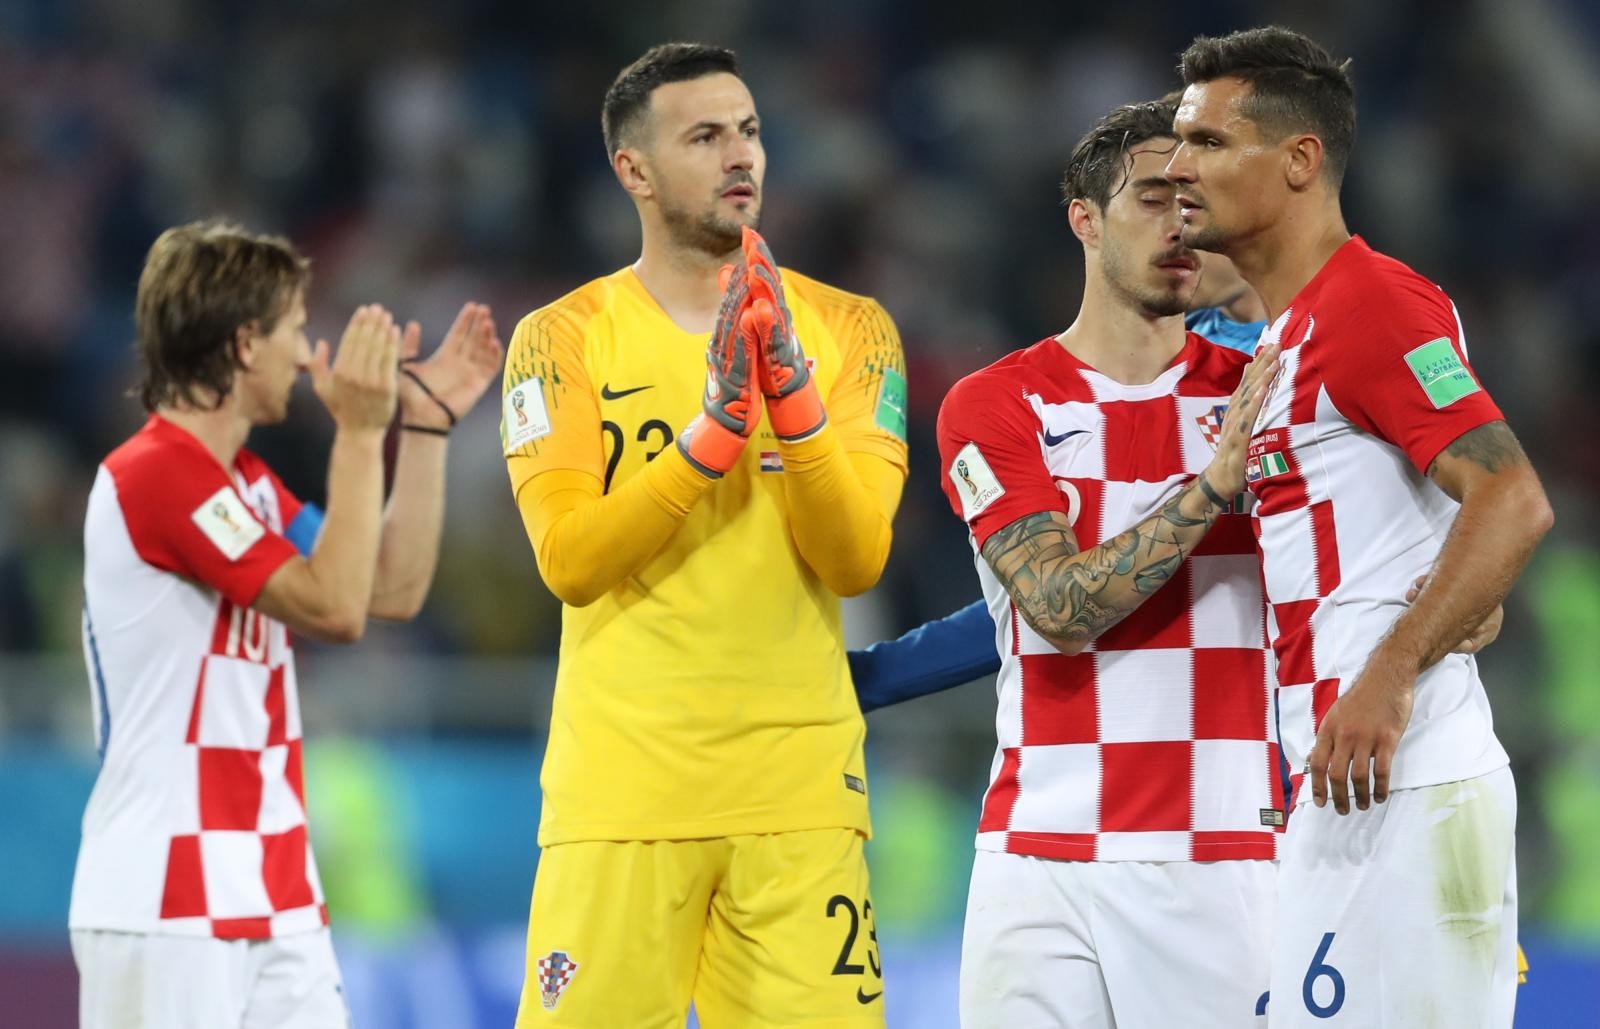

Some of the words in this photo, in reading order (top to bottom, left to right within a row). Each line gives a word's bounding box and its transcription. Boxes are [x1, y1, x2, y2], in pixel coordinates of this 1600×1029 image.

[225, 605, 268, 664] 10
[826, 894, 882, 980] 23
[1302, 932, 1346, 1019] 6
